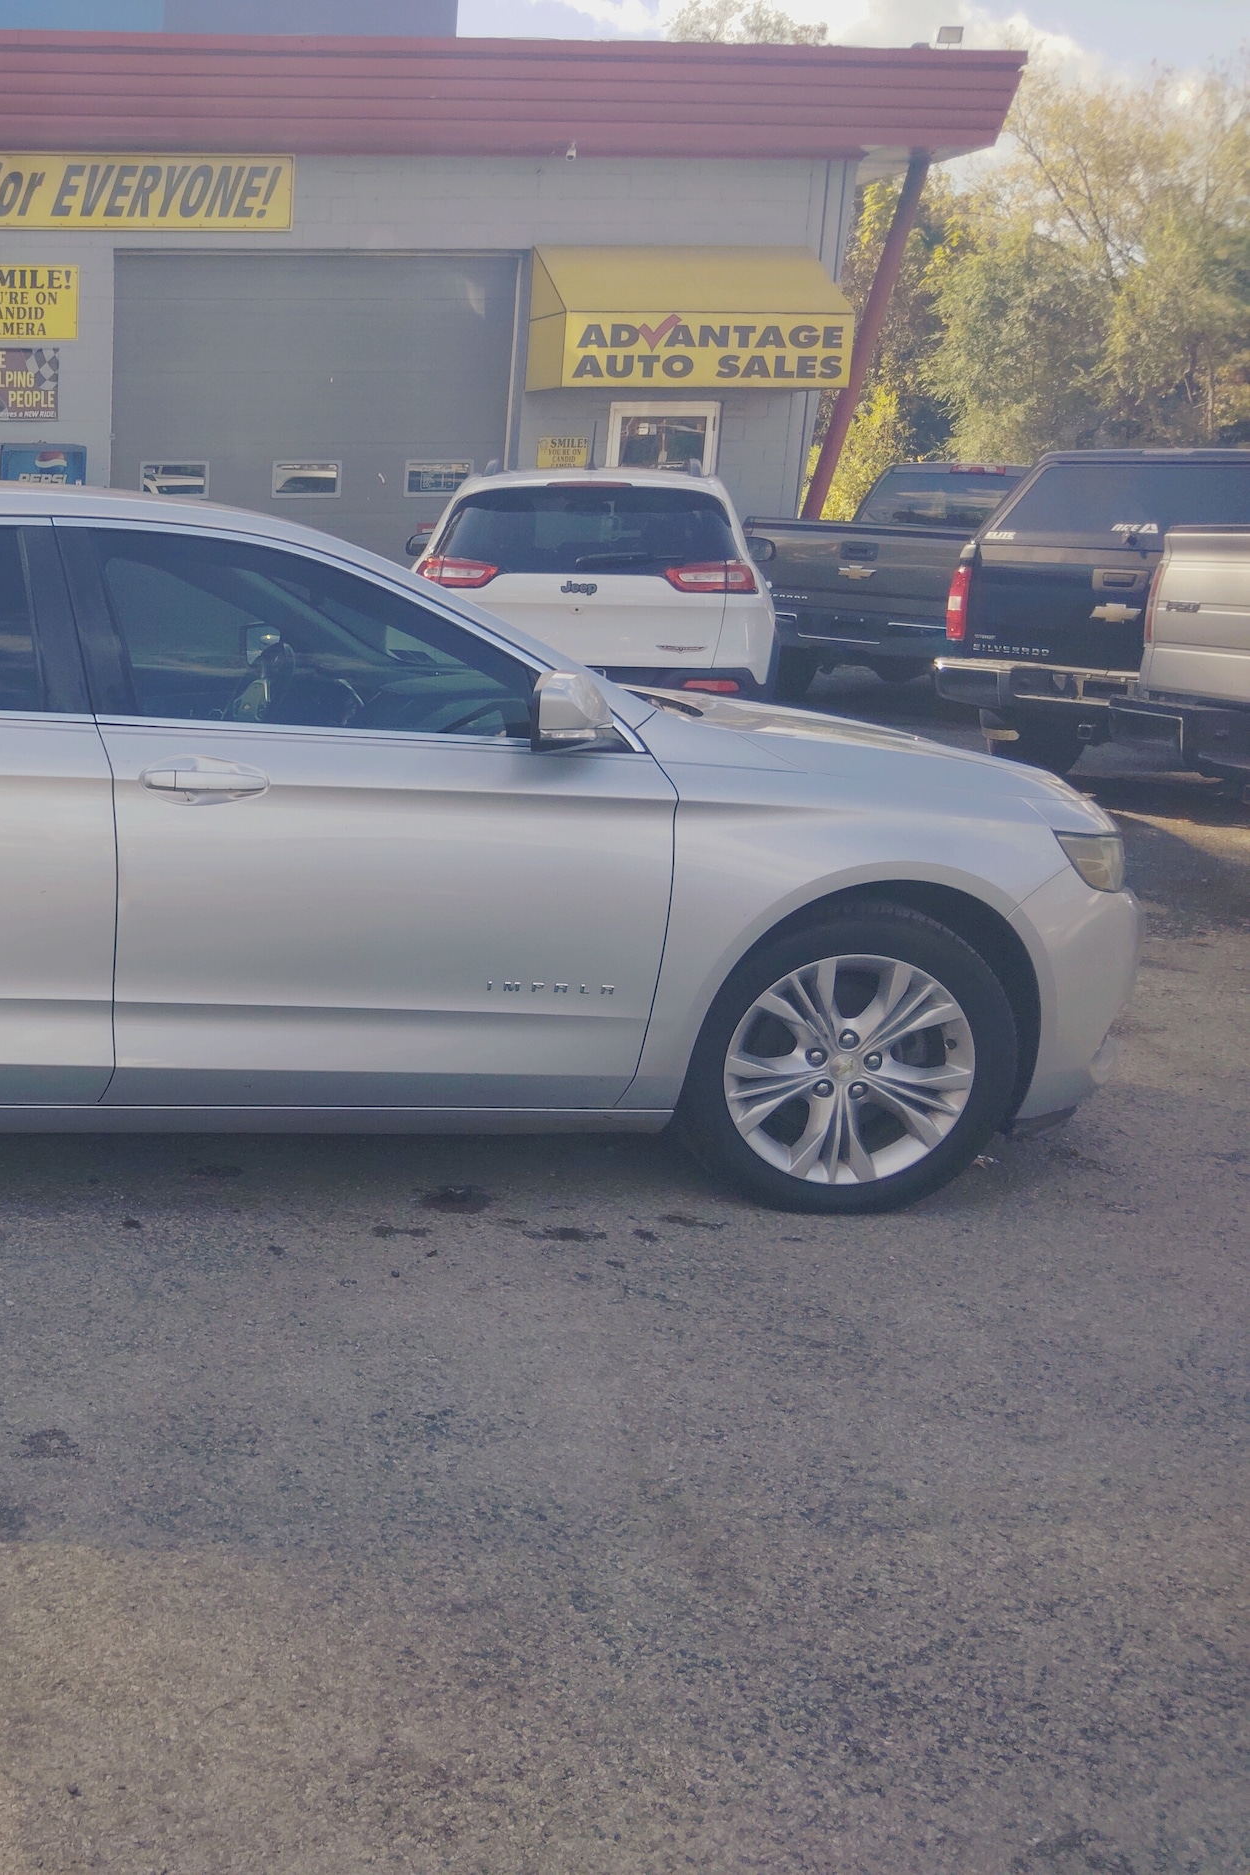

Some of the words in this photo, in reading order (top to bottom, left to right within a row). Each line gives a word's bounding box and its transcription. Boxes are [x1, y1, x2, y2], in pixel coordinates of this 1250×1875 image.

[50, 164, 283, 219] EVERYONE!
[35, 291, 58, 305] ON
[576, 313, 844, 351] ADVANTAGE
[571, 354, 695, 378] AUTO
[715, 354, 843, 379] SALES
[8, 390, 56, 408] PEOPLE
[23, 410, 39, 418] NEW
[550, 438, 587, 449] SMILE!
[552, 455, 576, 463] CANDID
[572, 448, 582, 456] ON
[560, 580, 598, 596] Jeep
[972, 643, 1050, 657] SILVERADO
[486, 980, 615, 995] IMPALA
